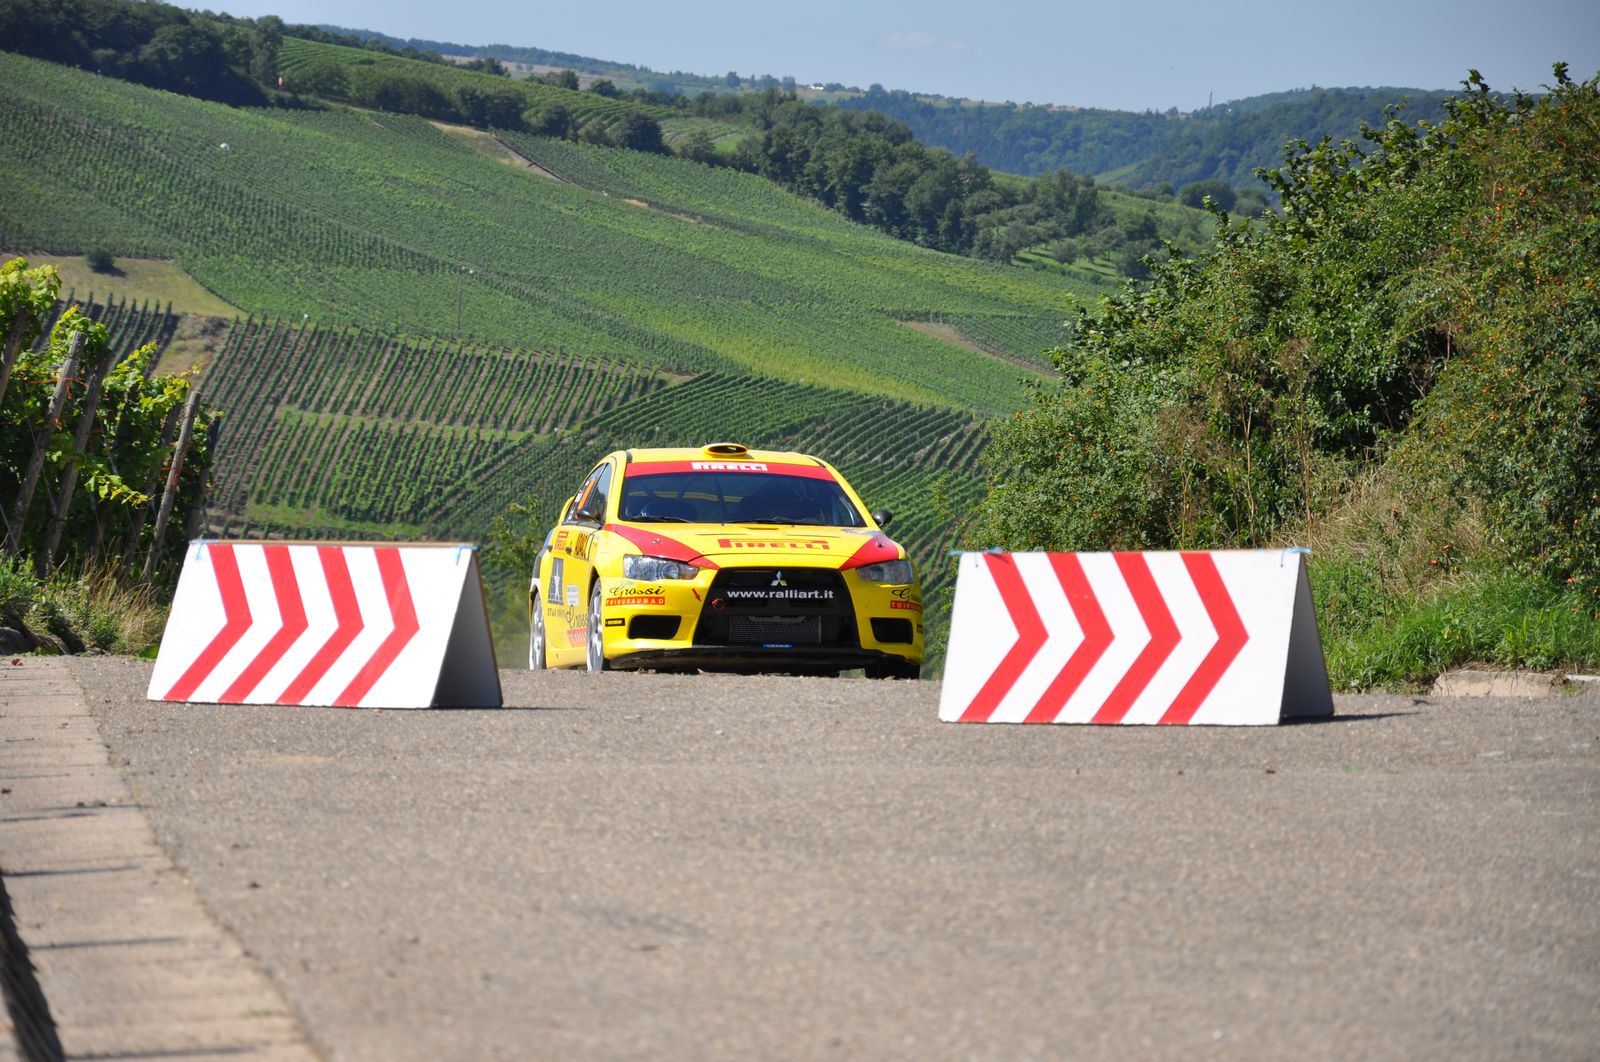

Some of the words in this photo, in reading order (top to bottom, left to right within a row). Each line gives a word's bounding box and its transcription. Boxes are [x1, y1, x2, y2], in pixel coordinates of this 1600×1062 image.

[691, 462, 768, 472] PIRELLI
[717, 538, 830, 550] PIRELLI
[609, 586, 666, 599] Grossi
[727, 590, 834, 599] www.ralliart.it
